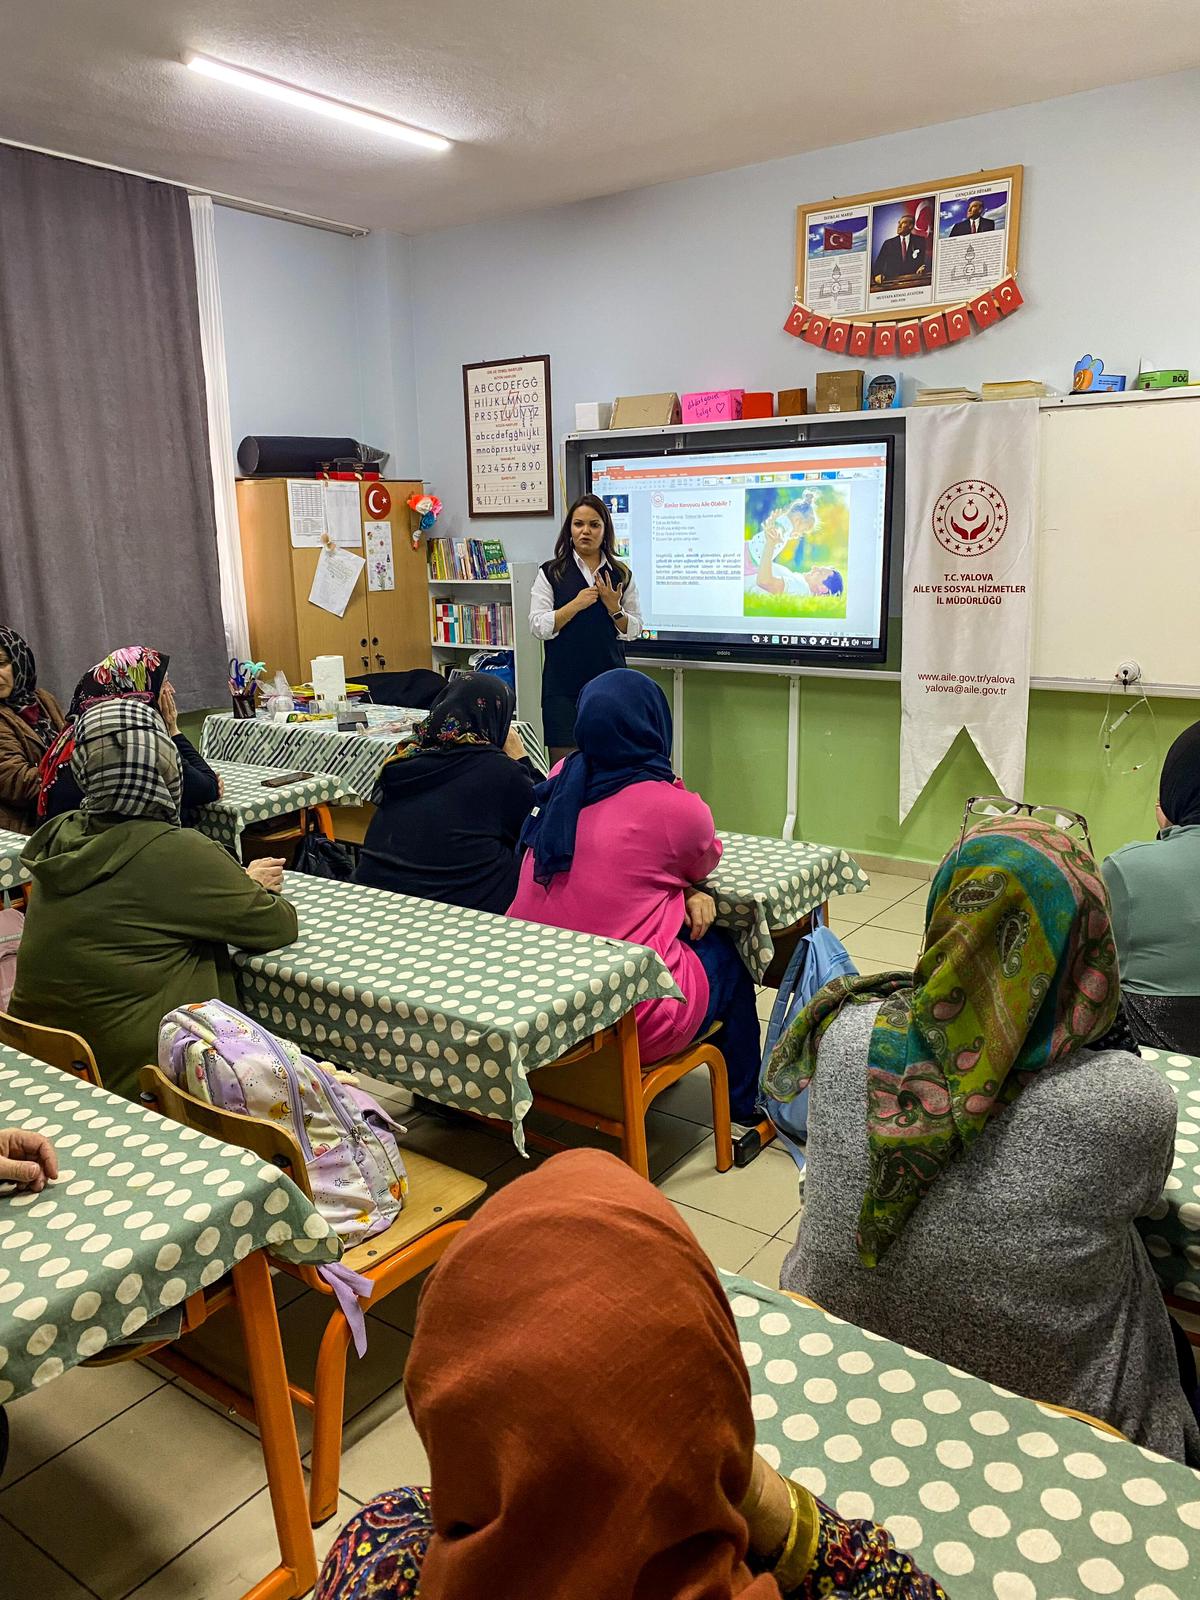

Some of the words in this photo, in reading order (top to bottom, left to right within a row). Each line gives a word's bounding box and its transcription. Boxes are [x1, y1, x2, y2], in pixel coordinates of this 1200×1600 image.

[944, 573, 959, 581] T.C.
[960, 573, 994, 581] YALOVA
[913, 584, 930, 593] AİLE
[931, 585, 942, 593] VE
[944, 585, 976, 593] SOSYAL
[977, 583, 1026, 593] HİZMETLER
[936, 595, 944, 604] İL
[945, 595, 1002, 605] MÜDÜRLÜĞÜ
[917, 673, 1016, 685] www.aile.gov.tr/yalova
[925, 684, 1007, 696] yalova@aile.gov.tr
